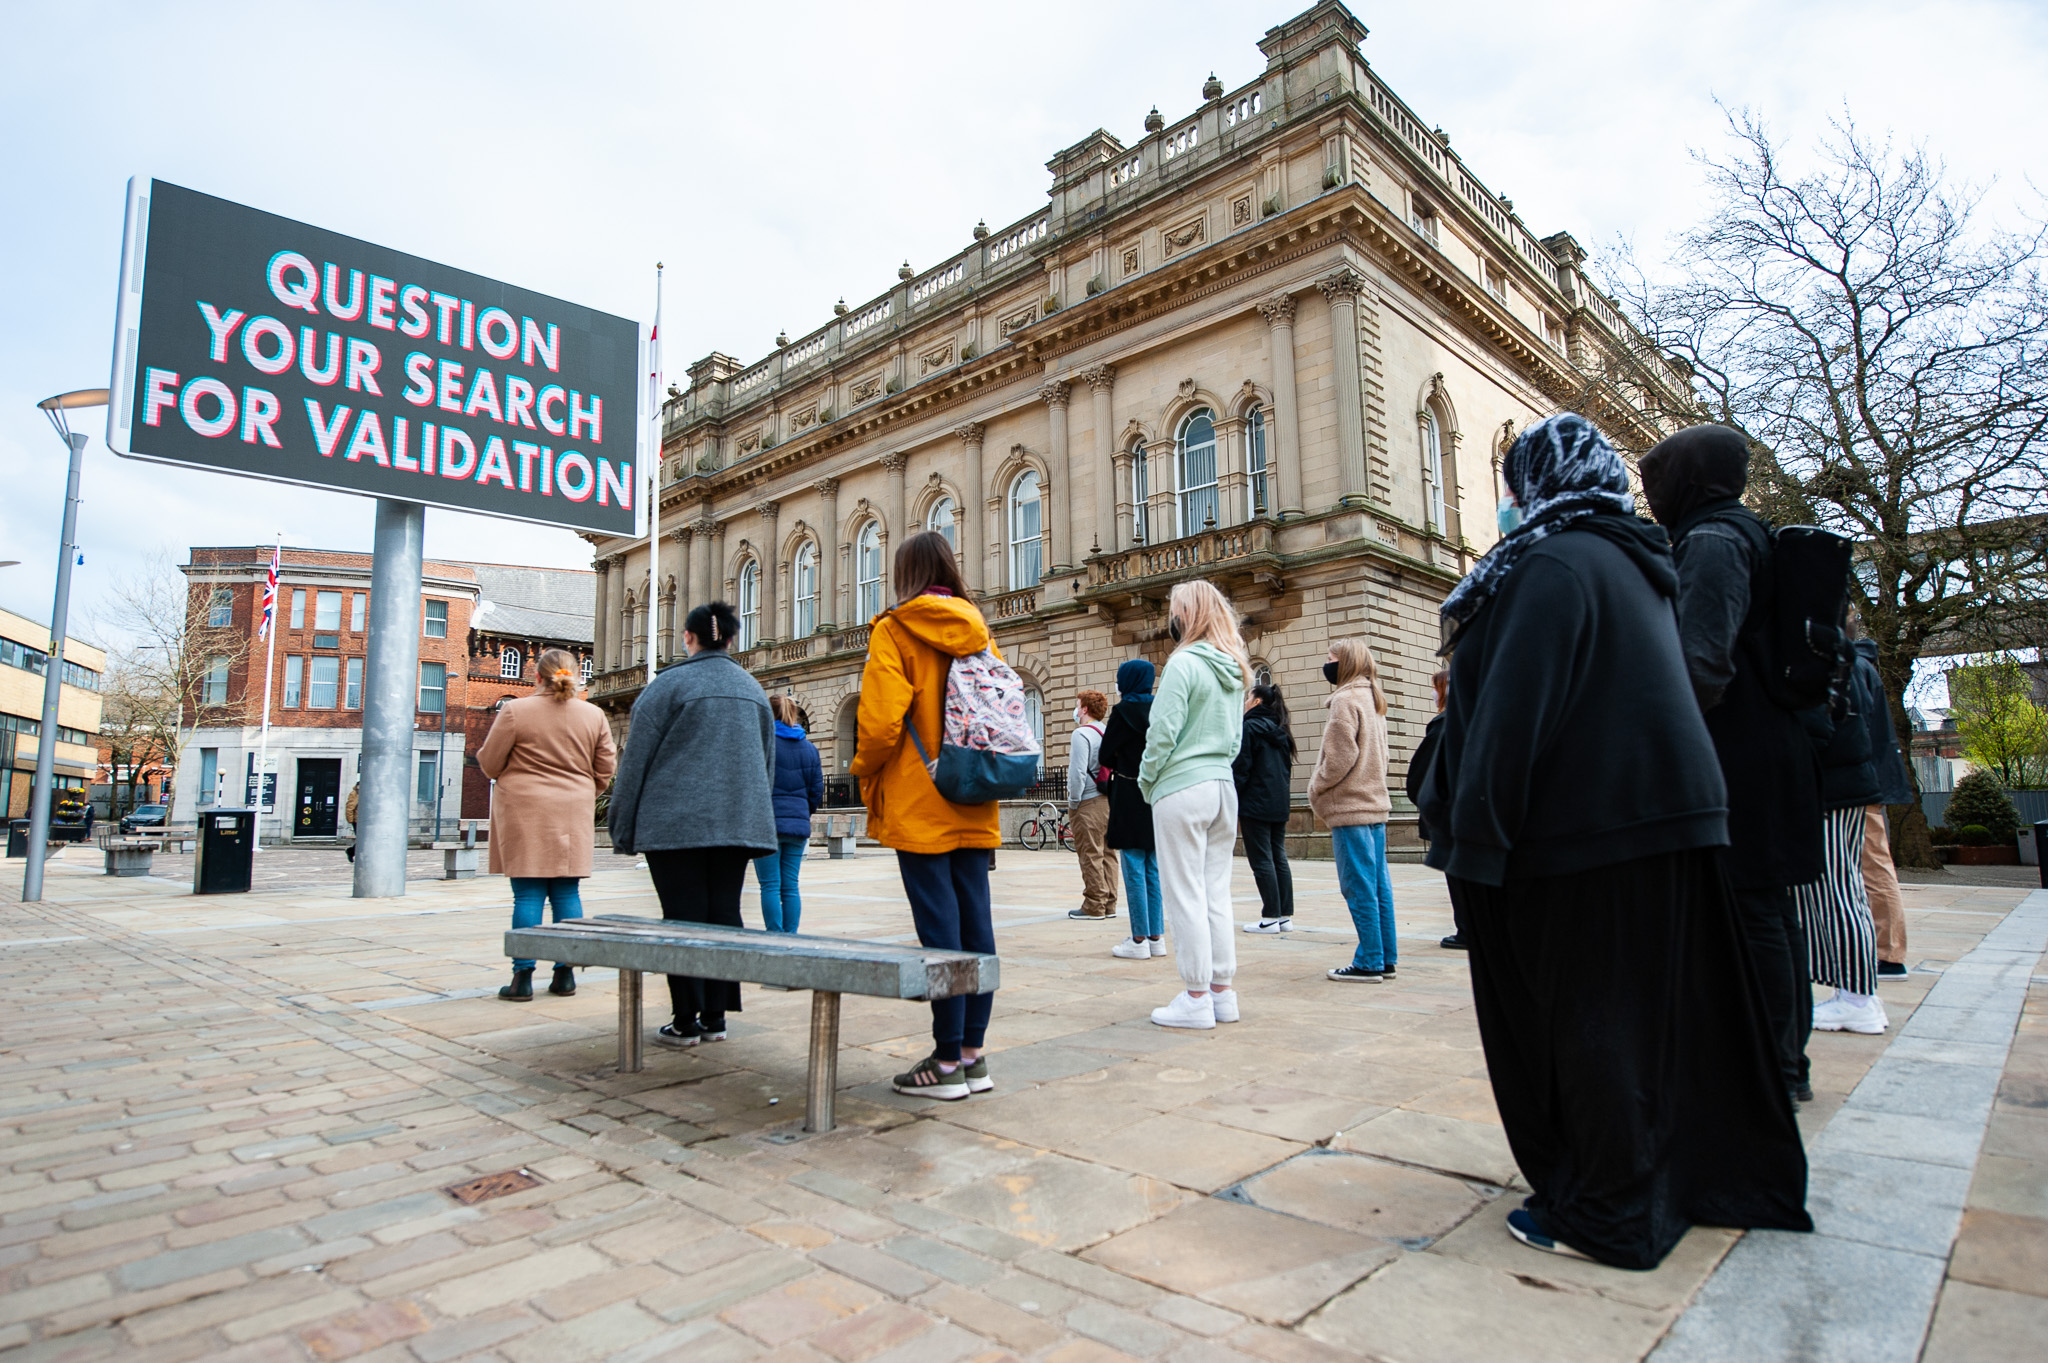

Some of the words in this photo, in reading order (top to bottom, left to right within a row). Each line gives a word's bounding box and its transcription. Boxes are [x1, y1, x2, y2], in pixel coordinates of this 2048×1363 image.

[197, 300, 384, 398] YOUR
[401, 350, 603, 445] SEARCH
[266, 250, 561, 373] QUESTION
[142, 366, 284, 449] FOR
[303, 397, 633, 511] VALIDATION
